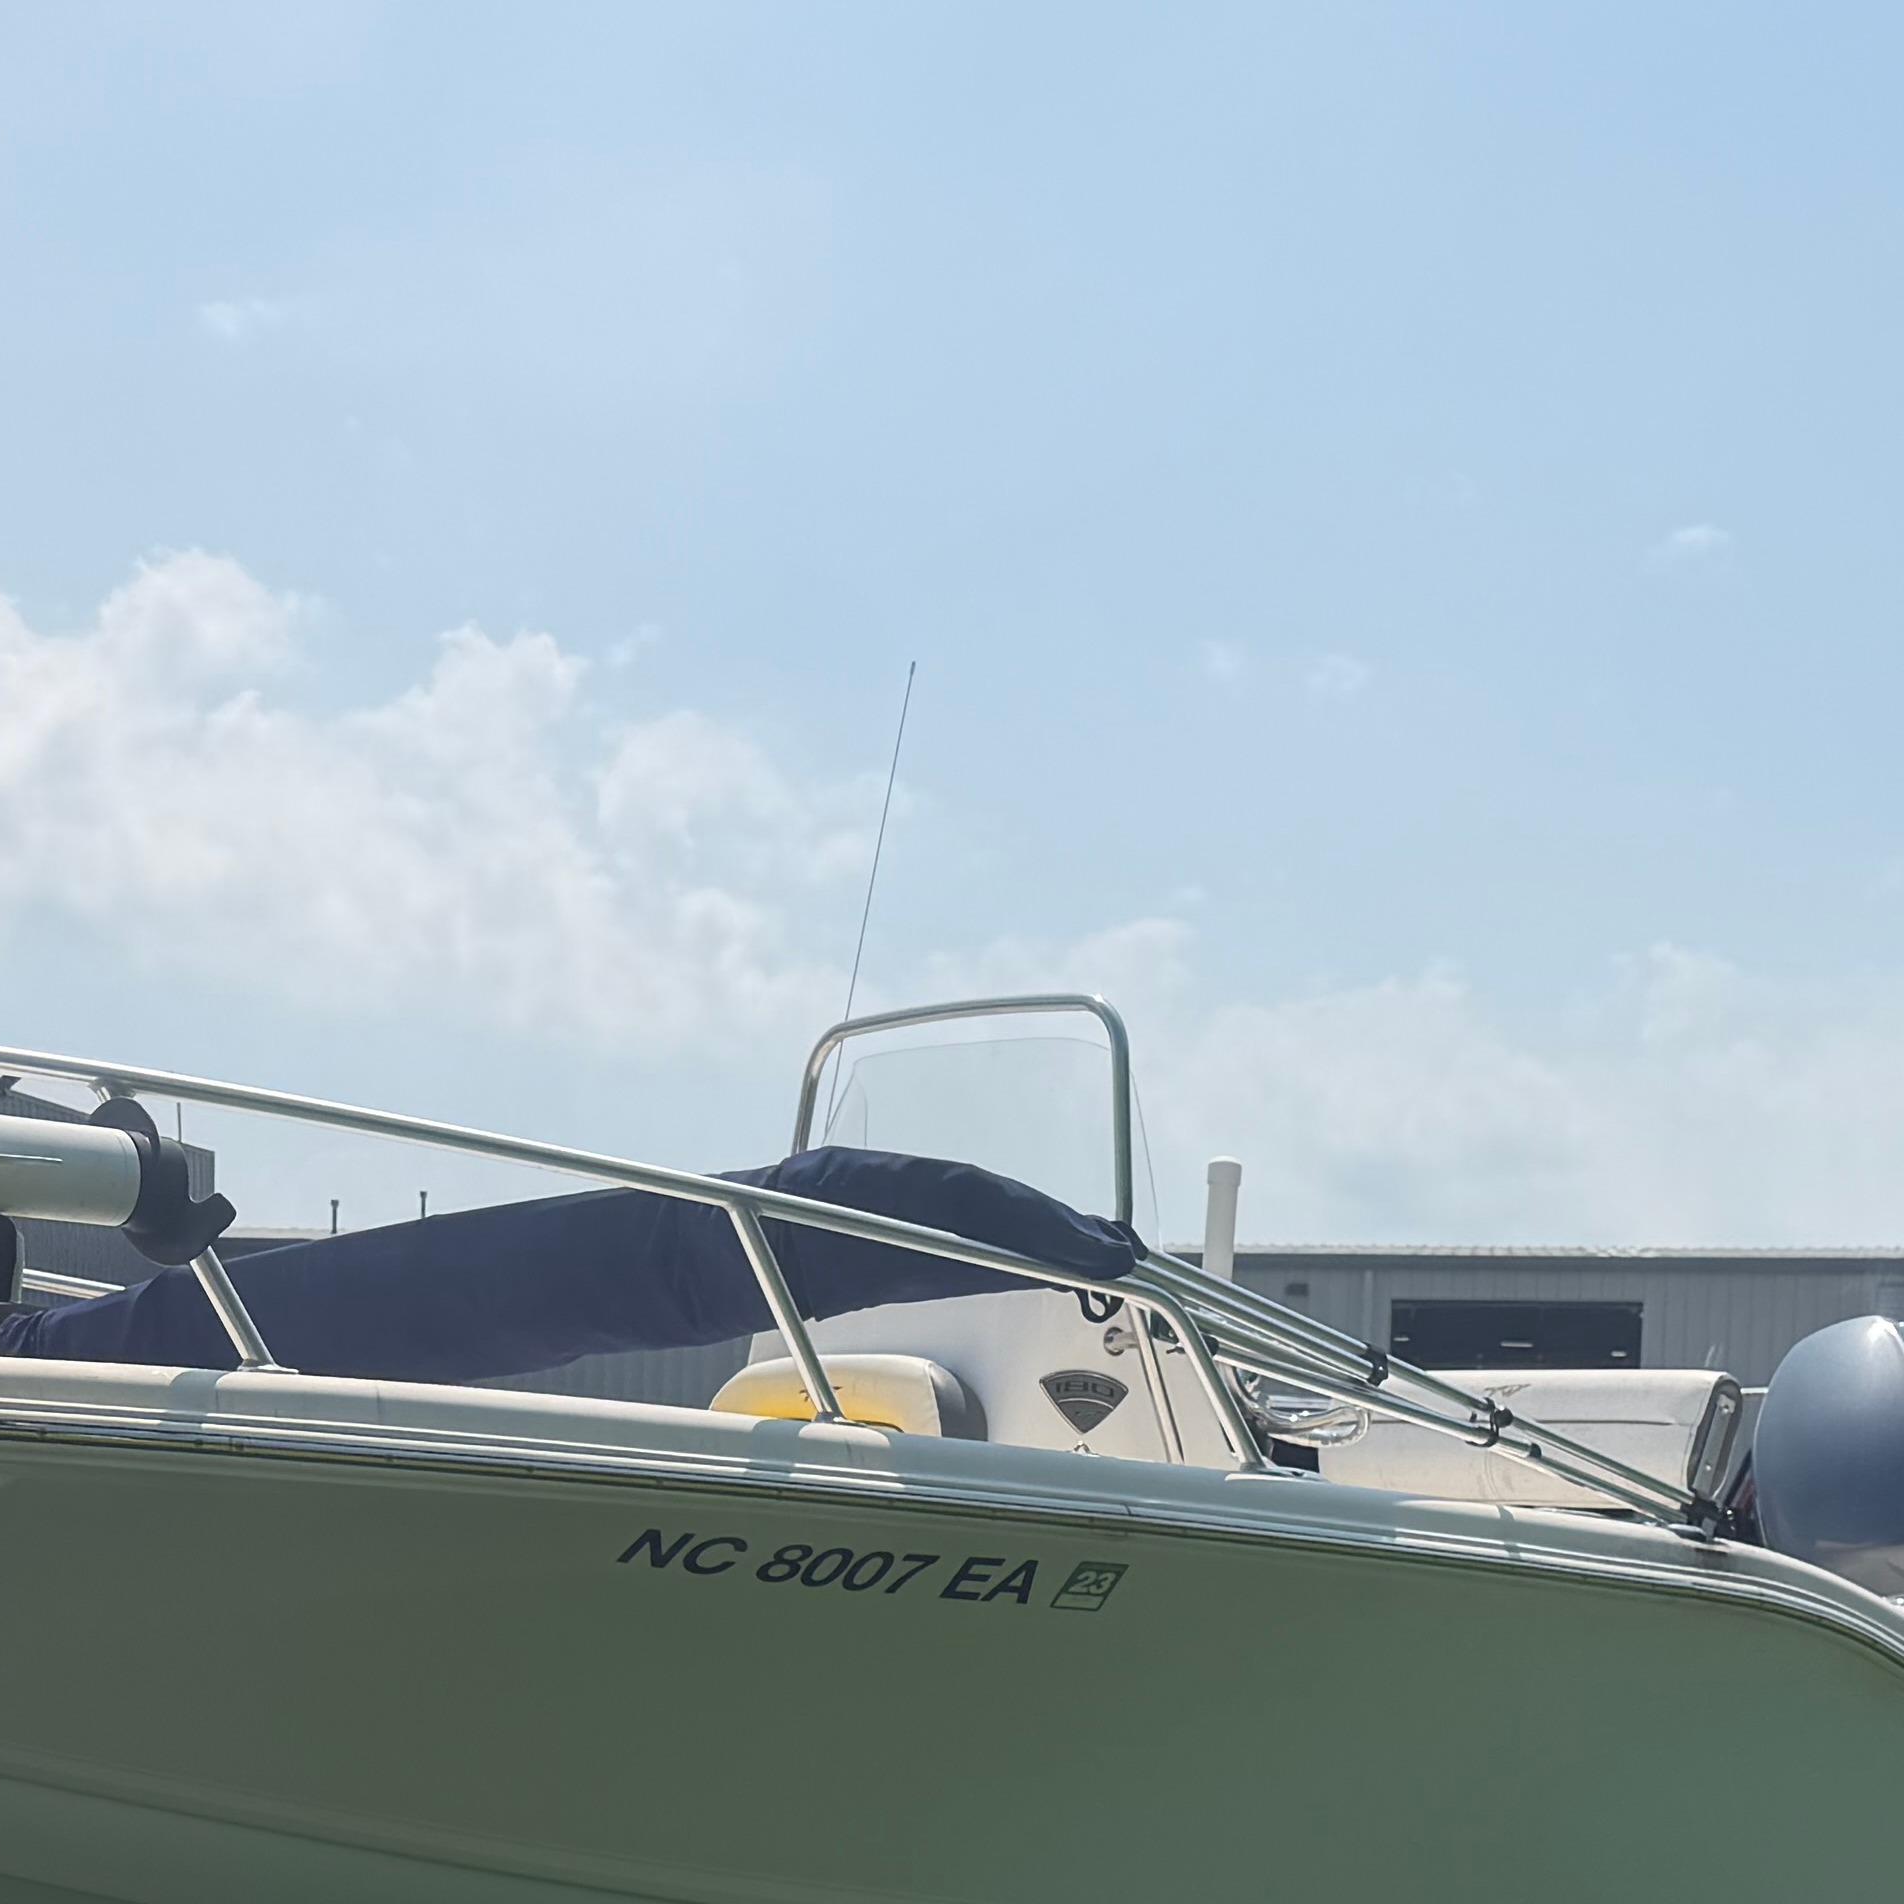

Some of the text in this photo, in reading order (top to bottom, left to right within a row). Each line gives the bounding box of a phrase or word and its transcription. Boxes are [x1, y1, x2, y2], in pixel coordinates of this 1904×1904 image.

[616, 1528, 1040, 1604] NC 8007 EA
[1066, 1570, 1117, 1594] 23
